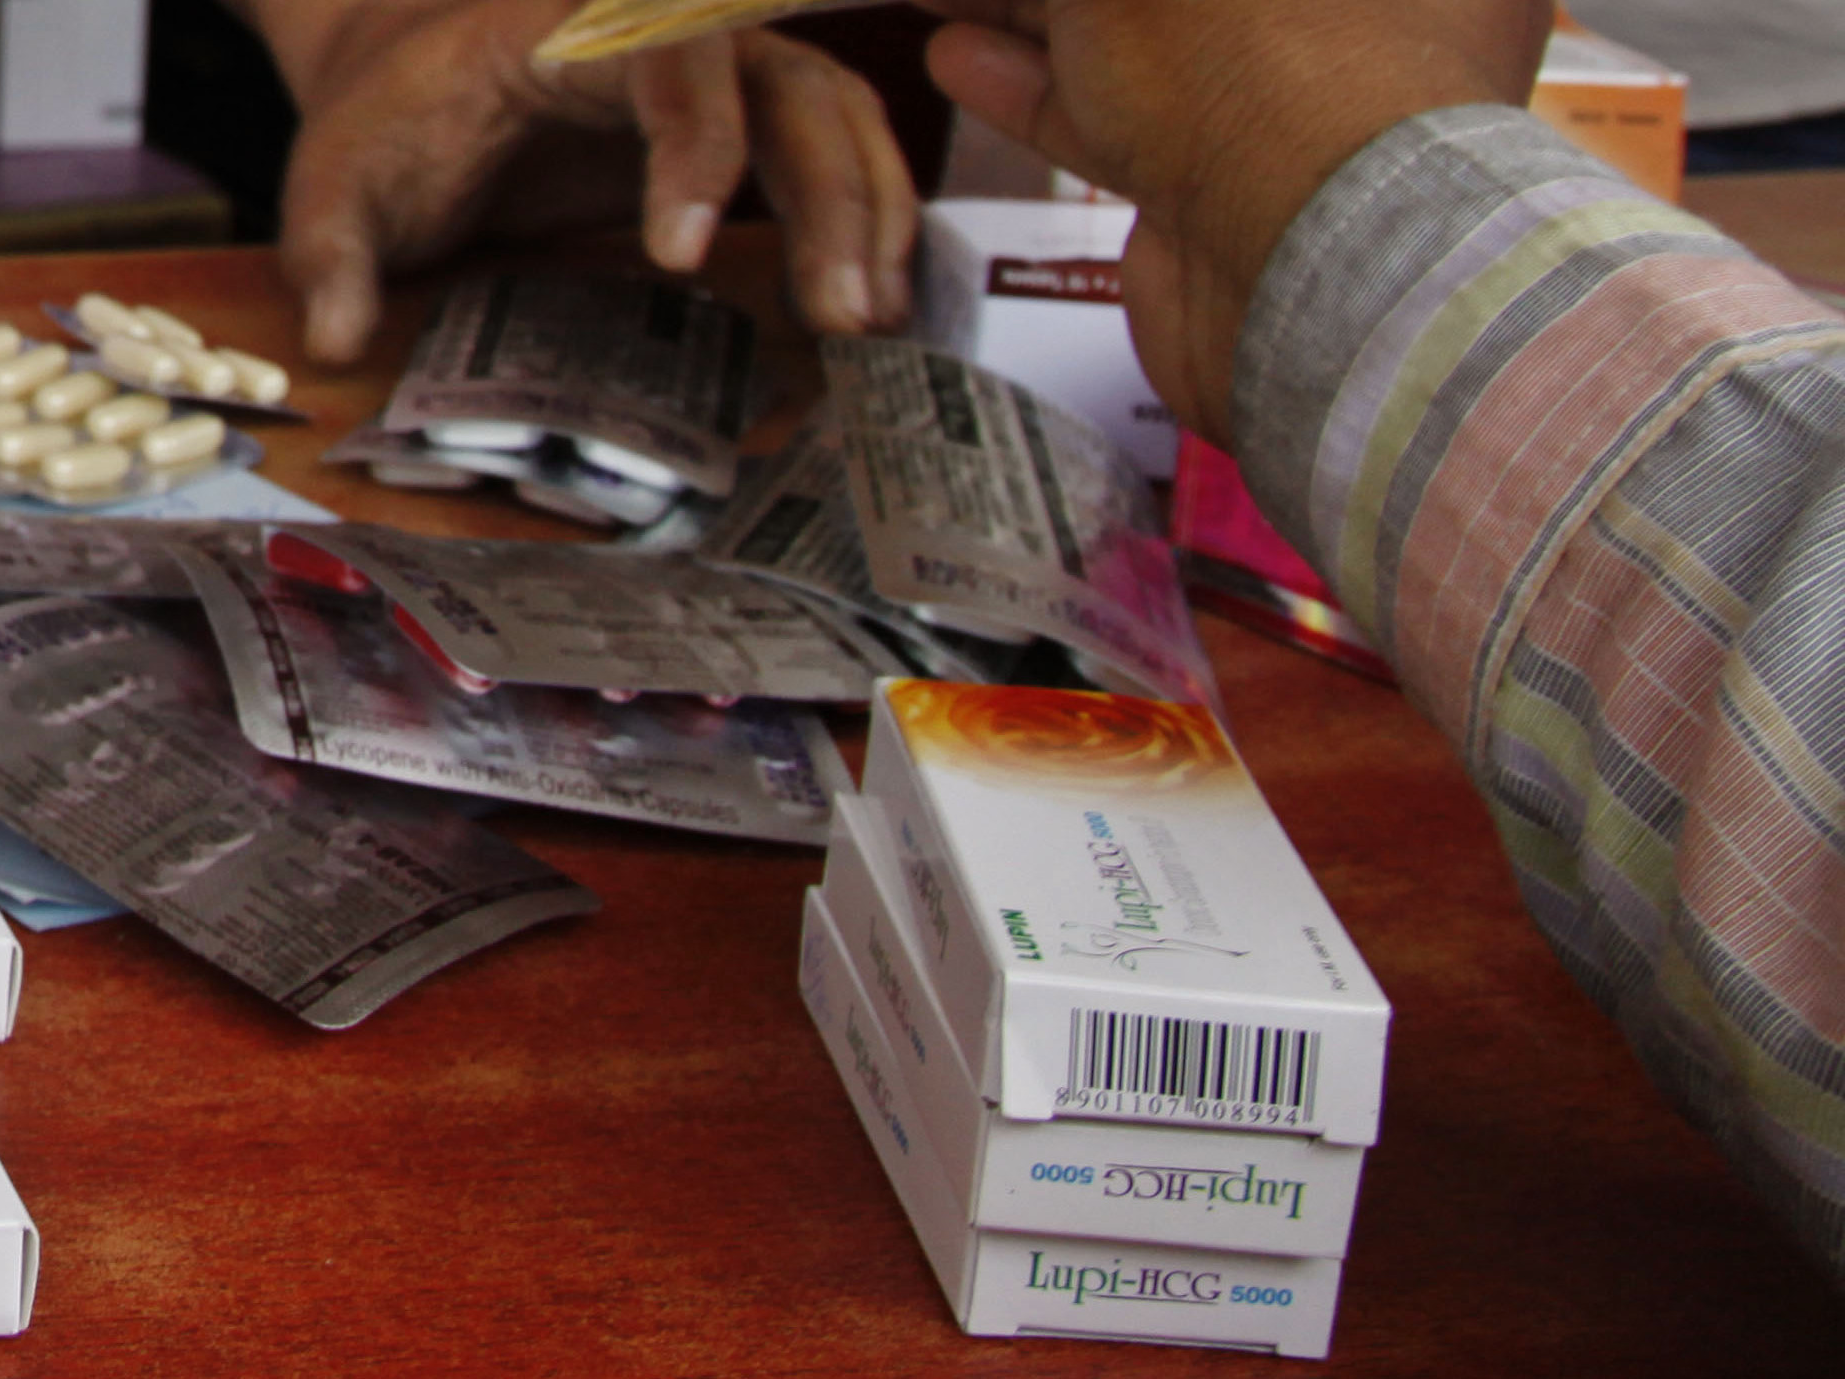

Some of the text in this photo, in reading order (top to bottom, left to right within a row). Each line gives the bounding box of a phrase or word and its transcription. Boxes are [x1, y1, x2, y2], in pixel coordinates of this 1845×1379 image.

[999, 908, 1043, 961] LUPIN
[1030, 1163, 1308, 1219] Lupi-HCG 5000
[1026, 1251, 1295, 1308] Lupi-HCG 5000
